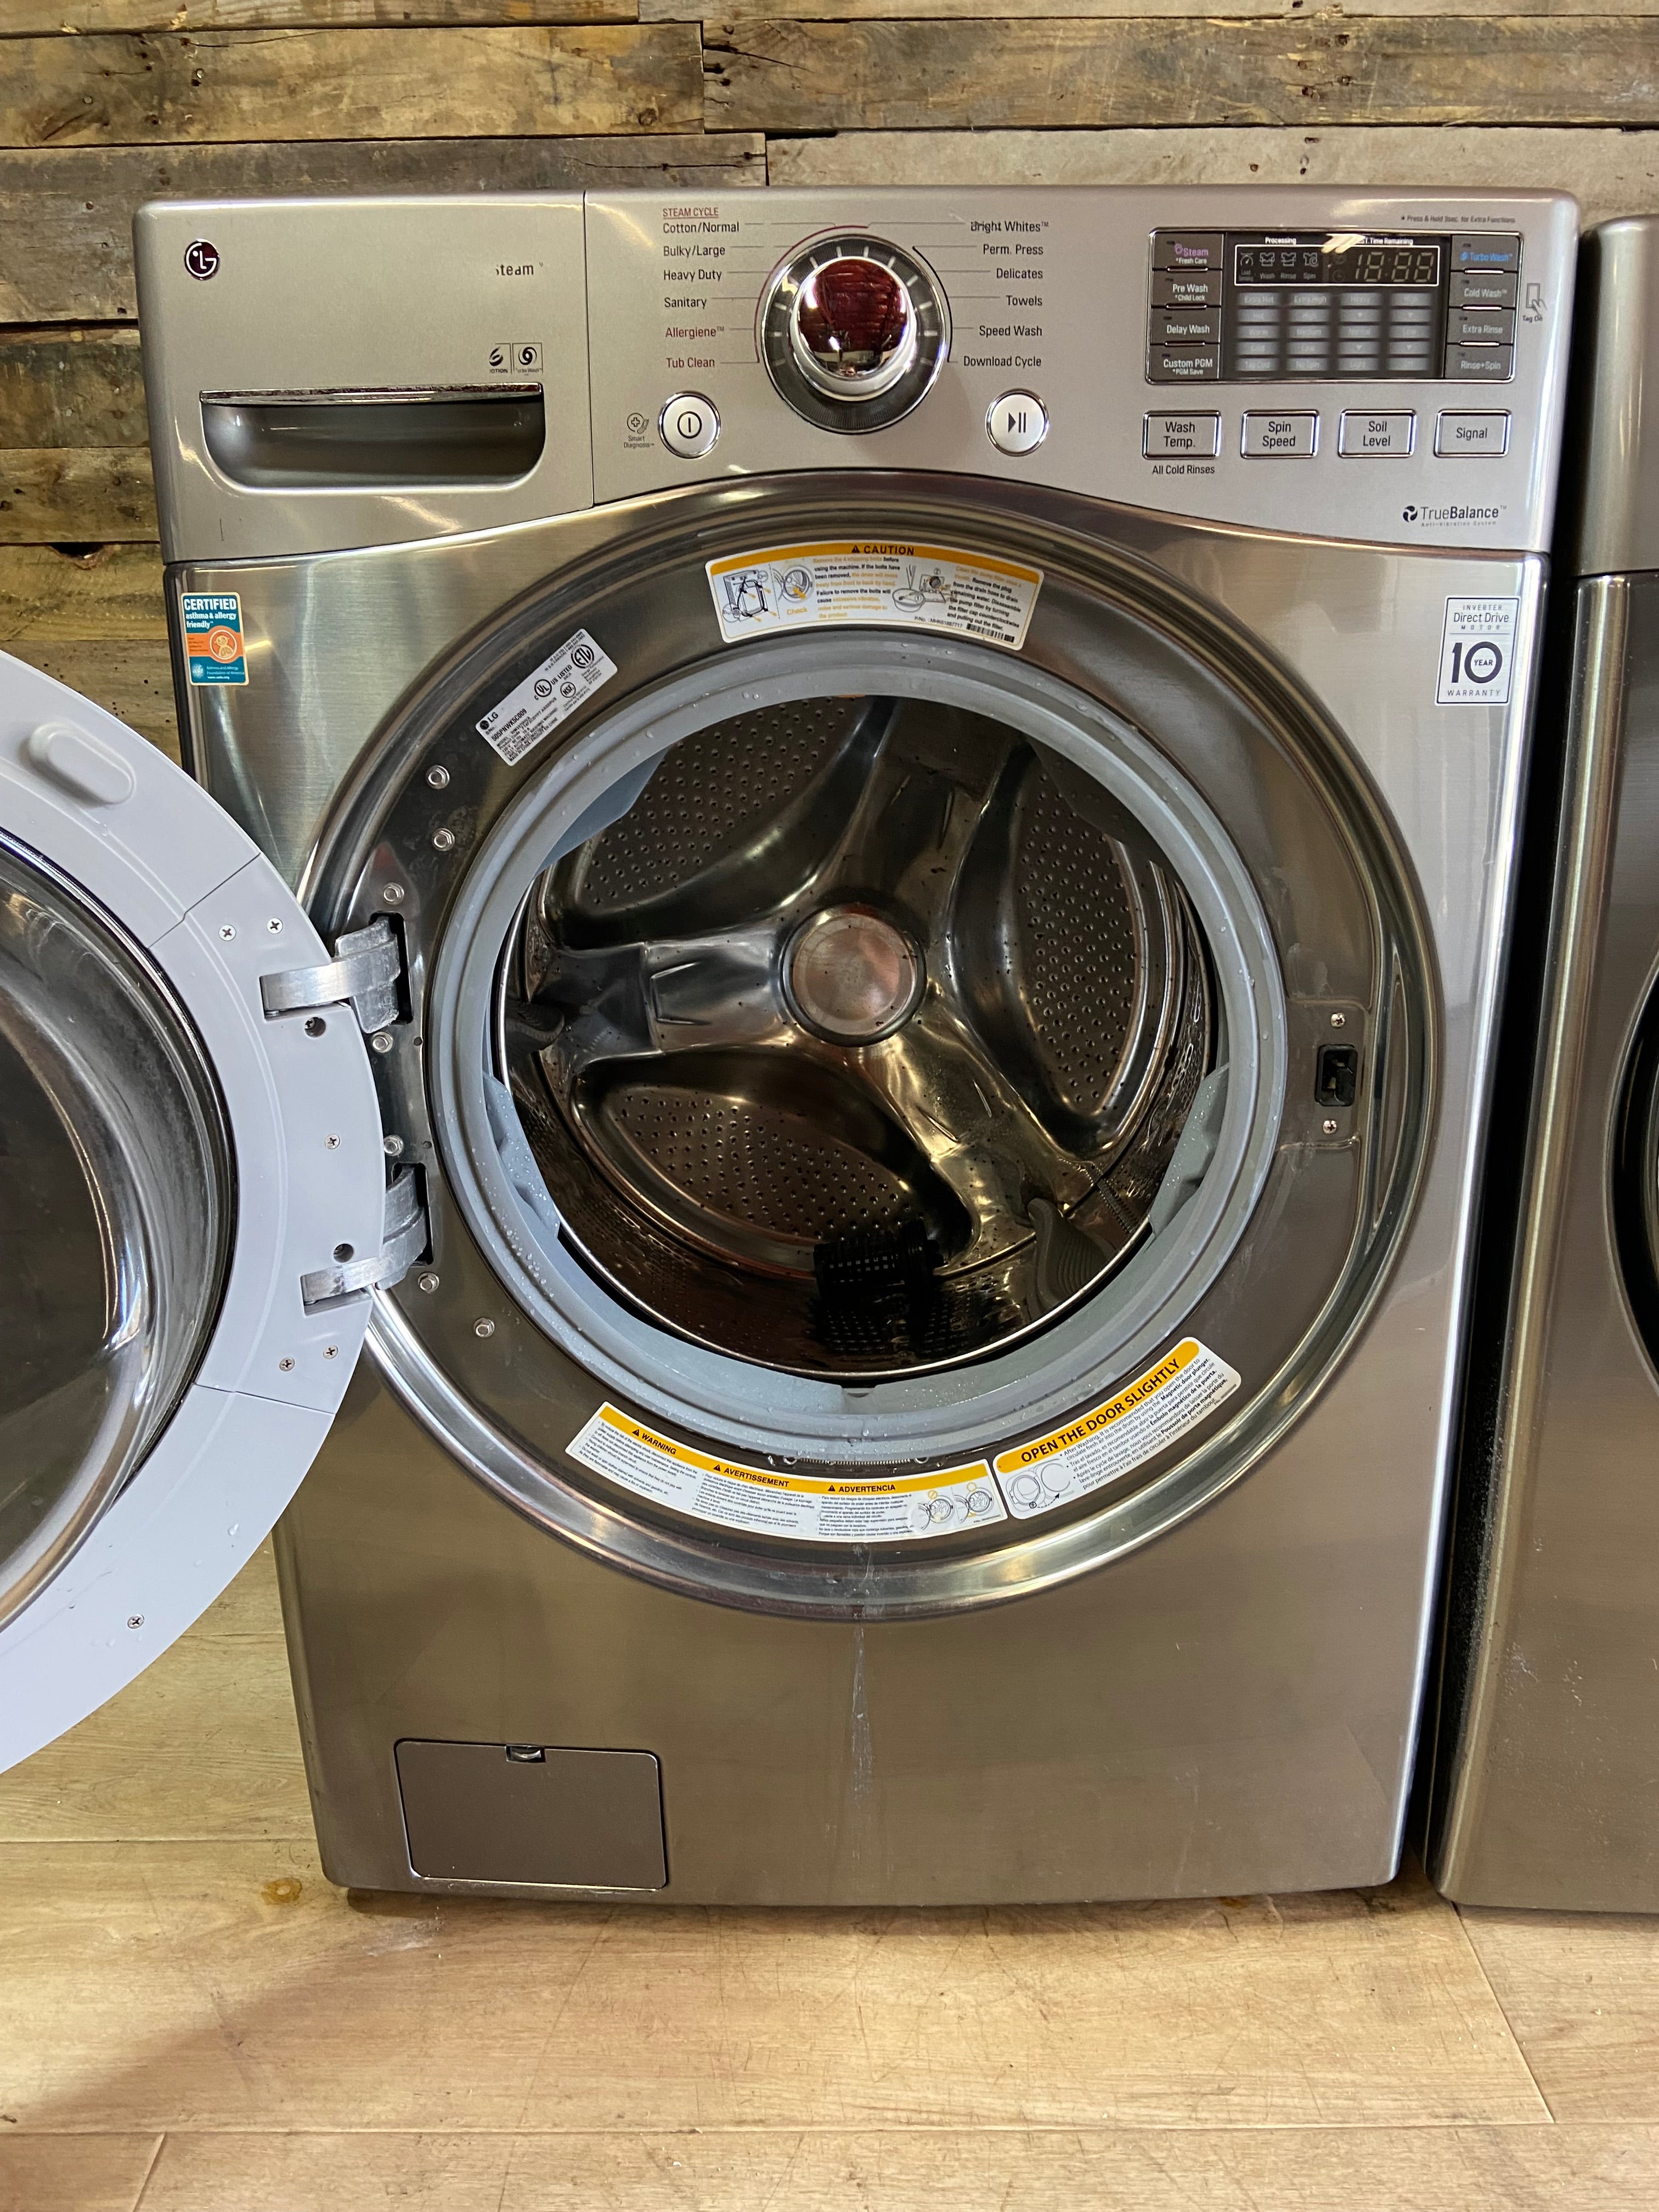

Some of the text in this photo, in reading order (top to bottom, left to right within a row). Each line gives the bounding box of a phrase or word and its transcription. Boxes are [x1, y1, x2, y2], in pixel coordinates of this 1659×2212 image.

[663, 207, 719, 217] STEAM CYCLE
[663, 221, 740, 234] Cotton/Normal
[970, 221, 1002, 234] Bright
[1265, 236, 1297, 245] Processing
[1384, 238, 1414, 246] Remaining
[663, 245, 726, 258] Bulky/Large
[983, 244, 1044, 255] Perm. Press
[1183, 247, 1209, 257] Steam
[185, 240, 218, 279] LG
[1470, 251, 1489, 262] Turbo
[663, 269, 722, 283] Heavy Duty
[996, 267, 1043, 279] Delicates
[1172, 283, 1208, 294] Pre Wash
[1464, 287, 1480, 297] Cold
[664, 296, 707, 309] Sanitary
[1006, 295, 1043, 306] Towels
[1522, 314, 1533, 323] Tag
[979, 325, 1043, 338] Speed Wash
[1166, 324, 1210, 335] Delay Wash
[1462, 324, 1503, 334] Extra Rinse
[666, 357, 715, 368] Tub Clean
[963, 356, 1042, 369] Download Cycle
[1163, 358, 1213, 368] Custom PGM
[1460, 360, 1501, 371] Rinse+Spin
[1165, 421, 1196, 433] Wash
[1268, 421, 1291, 435] Spin
[1368, 420, 1387, 432] Soil
[1455, 427, 1488, 441] Signal
[1163, 436, 1197, 450] Temp.
[1262, 435, 1296, 449] Speed
[1362, 435, 1391, 447] Level
[1152, 465, 1215, 475] All Cold Rinses
[864, 545, 915, 556] CAUTION
[184, 598, 237, 611] CERTIFIED
[185, 611, 209, 619] asthma
[215, 611, 237, 620] allergy
[1453, 612, 1509, 623] Direct Drive
[1451, 641, 1503, 684] 10
[550, 677, 558, 686] US
[557, 664, 573, 680] LISTED
[487, 711, 499, 723] LG
[1021, 1358, 1180, 1463] OPEN THE DOOR SLIGHTLY
[1064, 1447, 1077, 1456] After
[1076, 1435, 1101, 1449] Washing,
[1109, 1404, 1144, 1431] recommended
[1143, 1397, 1155, 1407] that
[1154, 1391, 1164, 1401] you
[1163, 1380, 1177, 1392] open
[1175, 1373, 1184, 1382] the
[1183, 1363, 1195, 1375] door
[1066, 1448, 1086, 1461] circulate
[1086, 1441, 1098, 1451] fresh
[1104, 1432, 1114, 1440] into
[1122, 1419, 1135, 1429] drum
[1140, 1406, 1154, 1417] using
[1152, 1399, 1161, 1408] the
[1160, 1383, 1182, 1401] Magnetic
[1181, 1374, 1192, 1385] door
[1192, 1358, 1210, 1376] plunger.
[1087, 1455, 1102, 1465] fresco
[1112, 1438, 1130, 1451] tambor
[1129, 1427, 1147, 1440] usando
[1149, 1412, 1169, 1426] Émbolo
[1167, 1393, 1191, 1413] magnético
[1200, 1370, 1217, 1386] puerta.
[1079, 1469, 1103, 1484] lave-linge
[1103, 1453, 1132, 1471] entrouverte,
[1138, 1436, 1157, 1451] utilisant
[1160, 1418, 1181, 1435] Poussoir
[1187, 1403, 1201, 1415] porte
[1199, 1379, 1228, 1404] magnétique,
[641, 1432, 677, 1455] WARNING
[724, 1466, 790, 1488] AVERTISSEMENT
[838, 1484, 896, 1493] ADVERTENCIA
